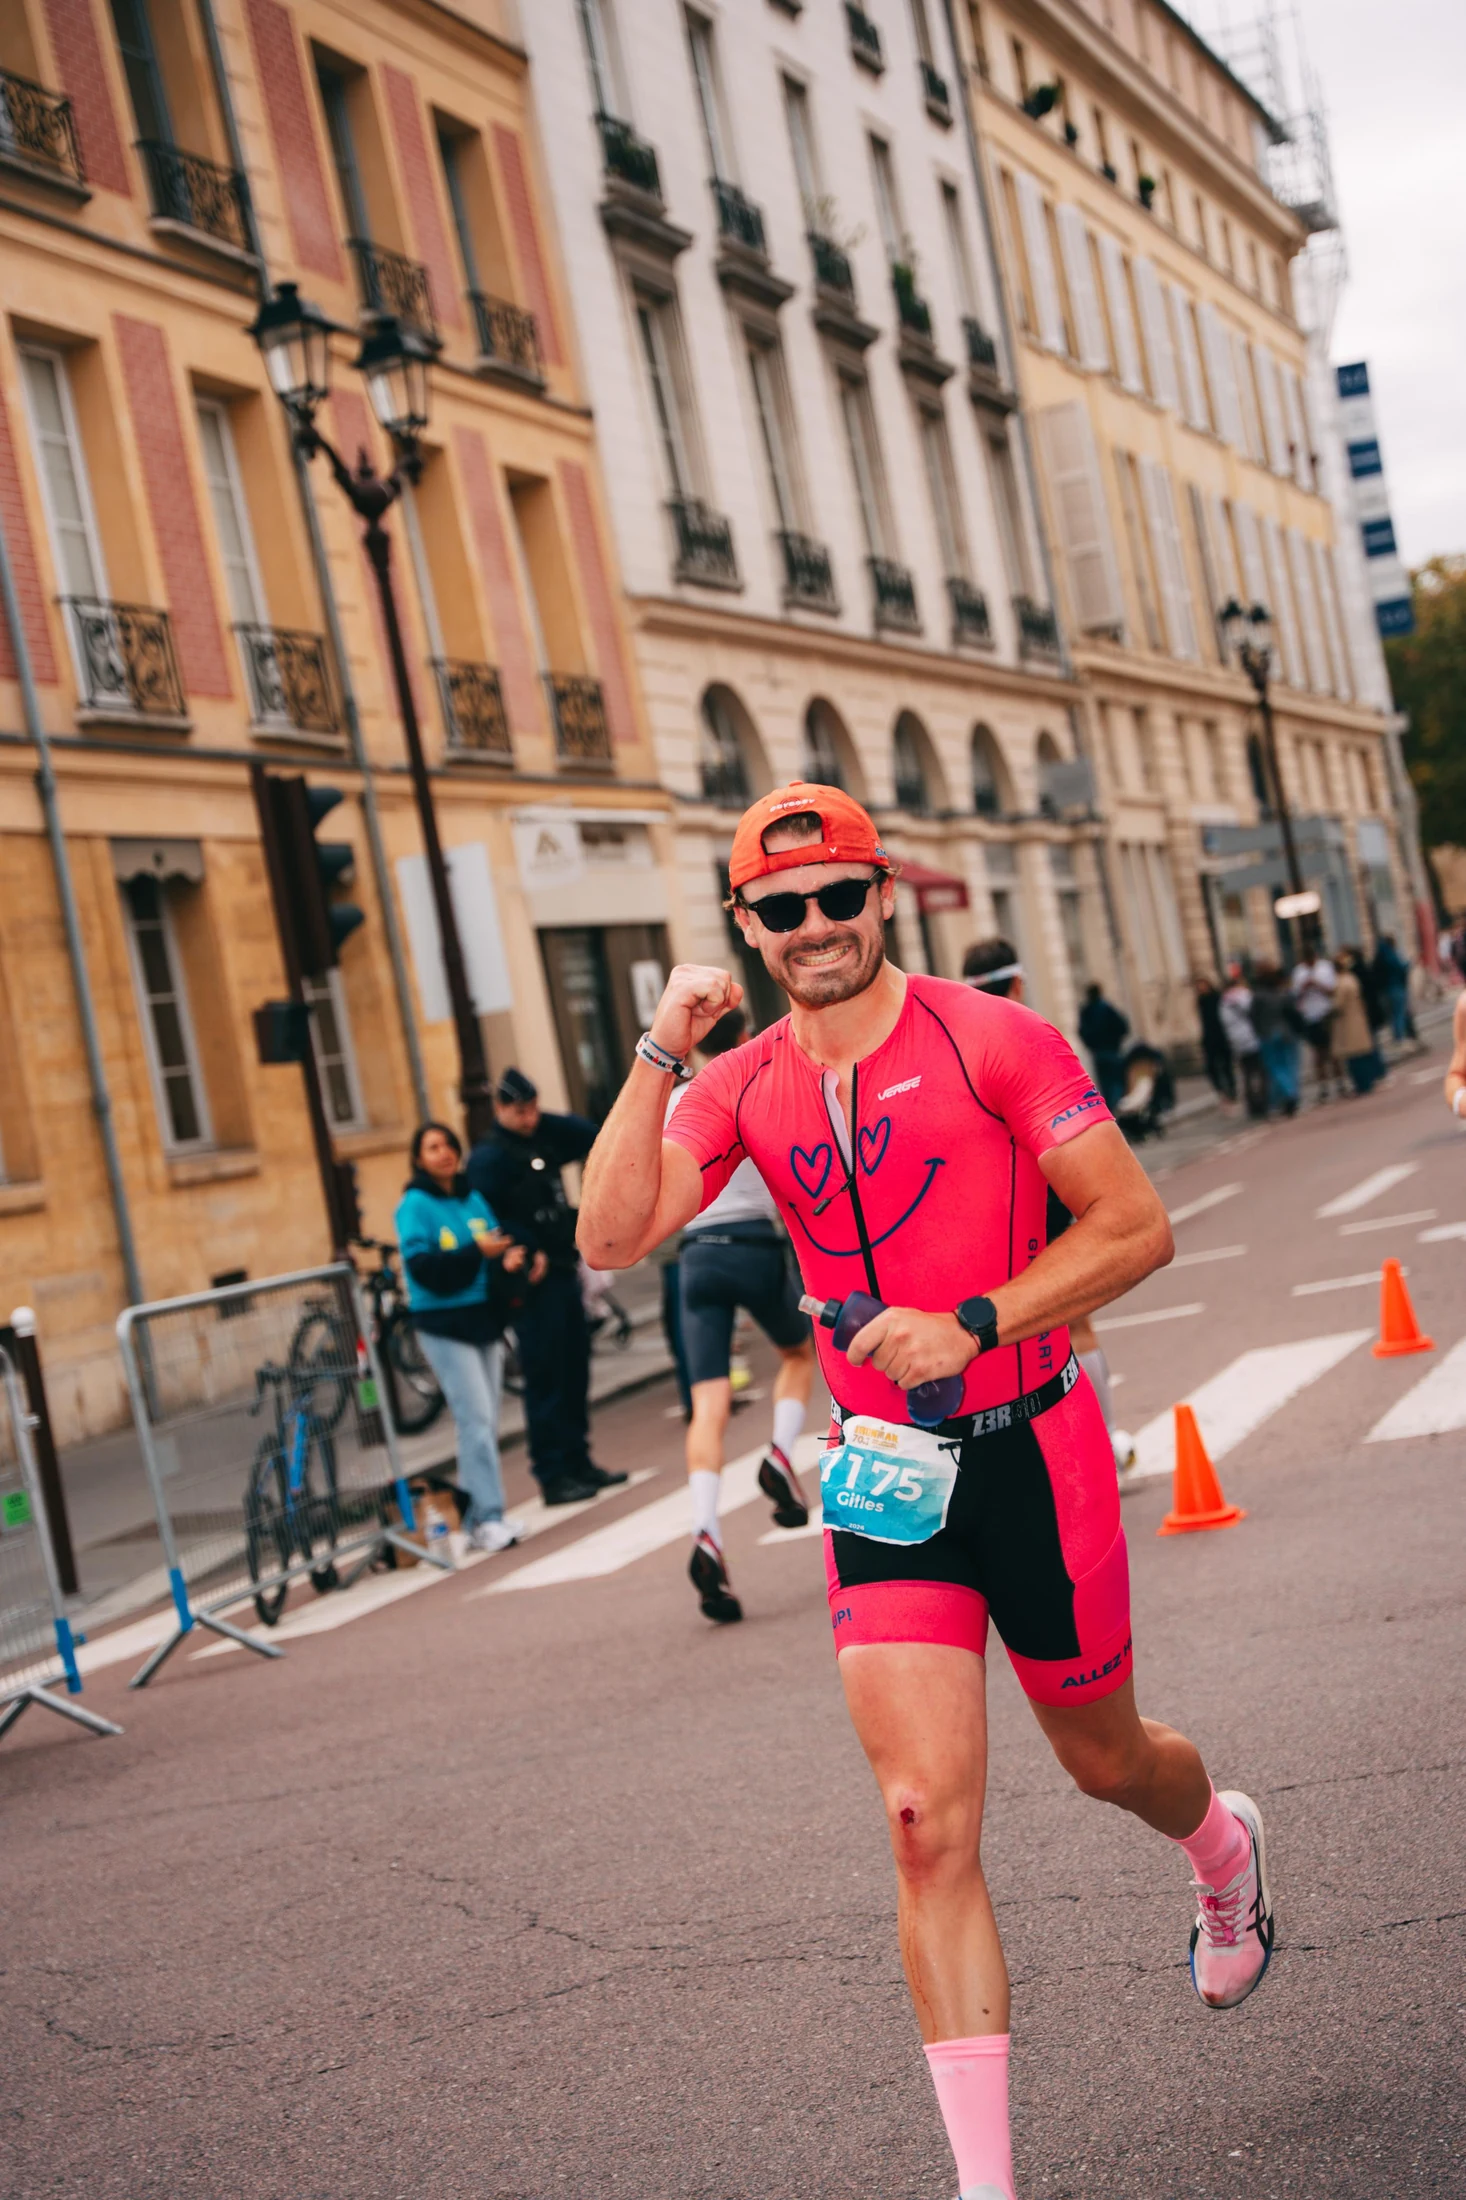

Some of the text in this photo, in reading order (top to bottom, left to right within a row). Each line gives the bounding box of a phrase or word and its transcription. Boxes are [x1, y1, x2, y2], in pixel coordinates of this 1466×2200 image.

[877, 1075, 922, 1101] VERGE
[820, 1450, 925, 1502] 7175
[1061, 1652, 1122, 1689] ALLEZ
